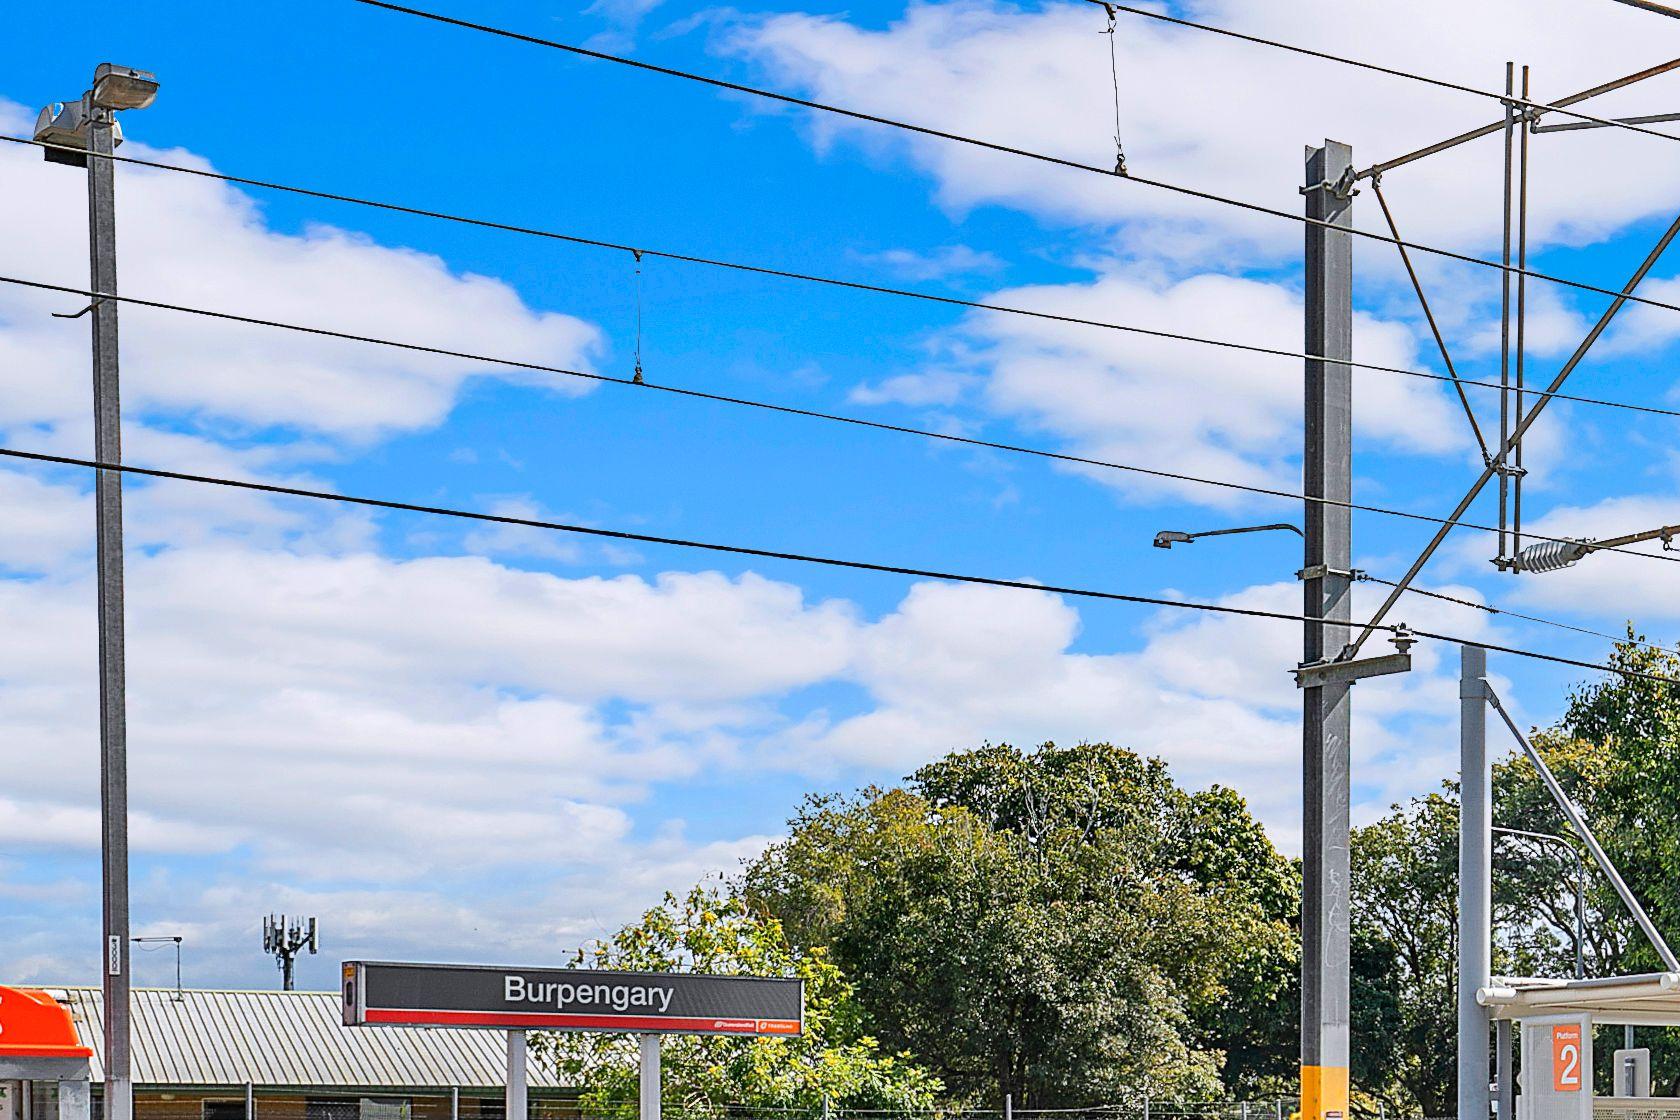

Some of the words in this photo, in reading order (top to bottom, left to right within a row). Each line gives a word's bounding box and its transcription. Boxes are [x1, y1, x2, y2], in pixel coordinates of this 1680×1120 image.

[504, 975, 675, 1013] Burpengary
[1556, 1032, 1579, 1040] Platform
[1560, 1044, 1578, 1085] 2
